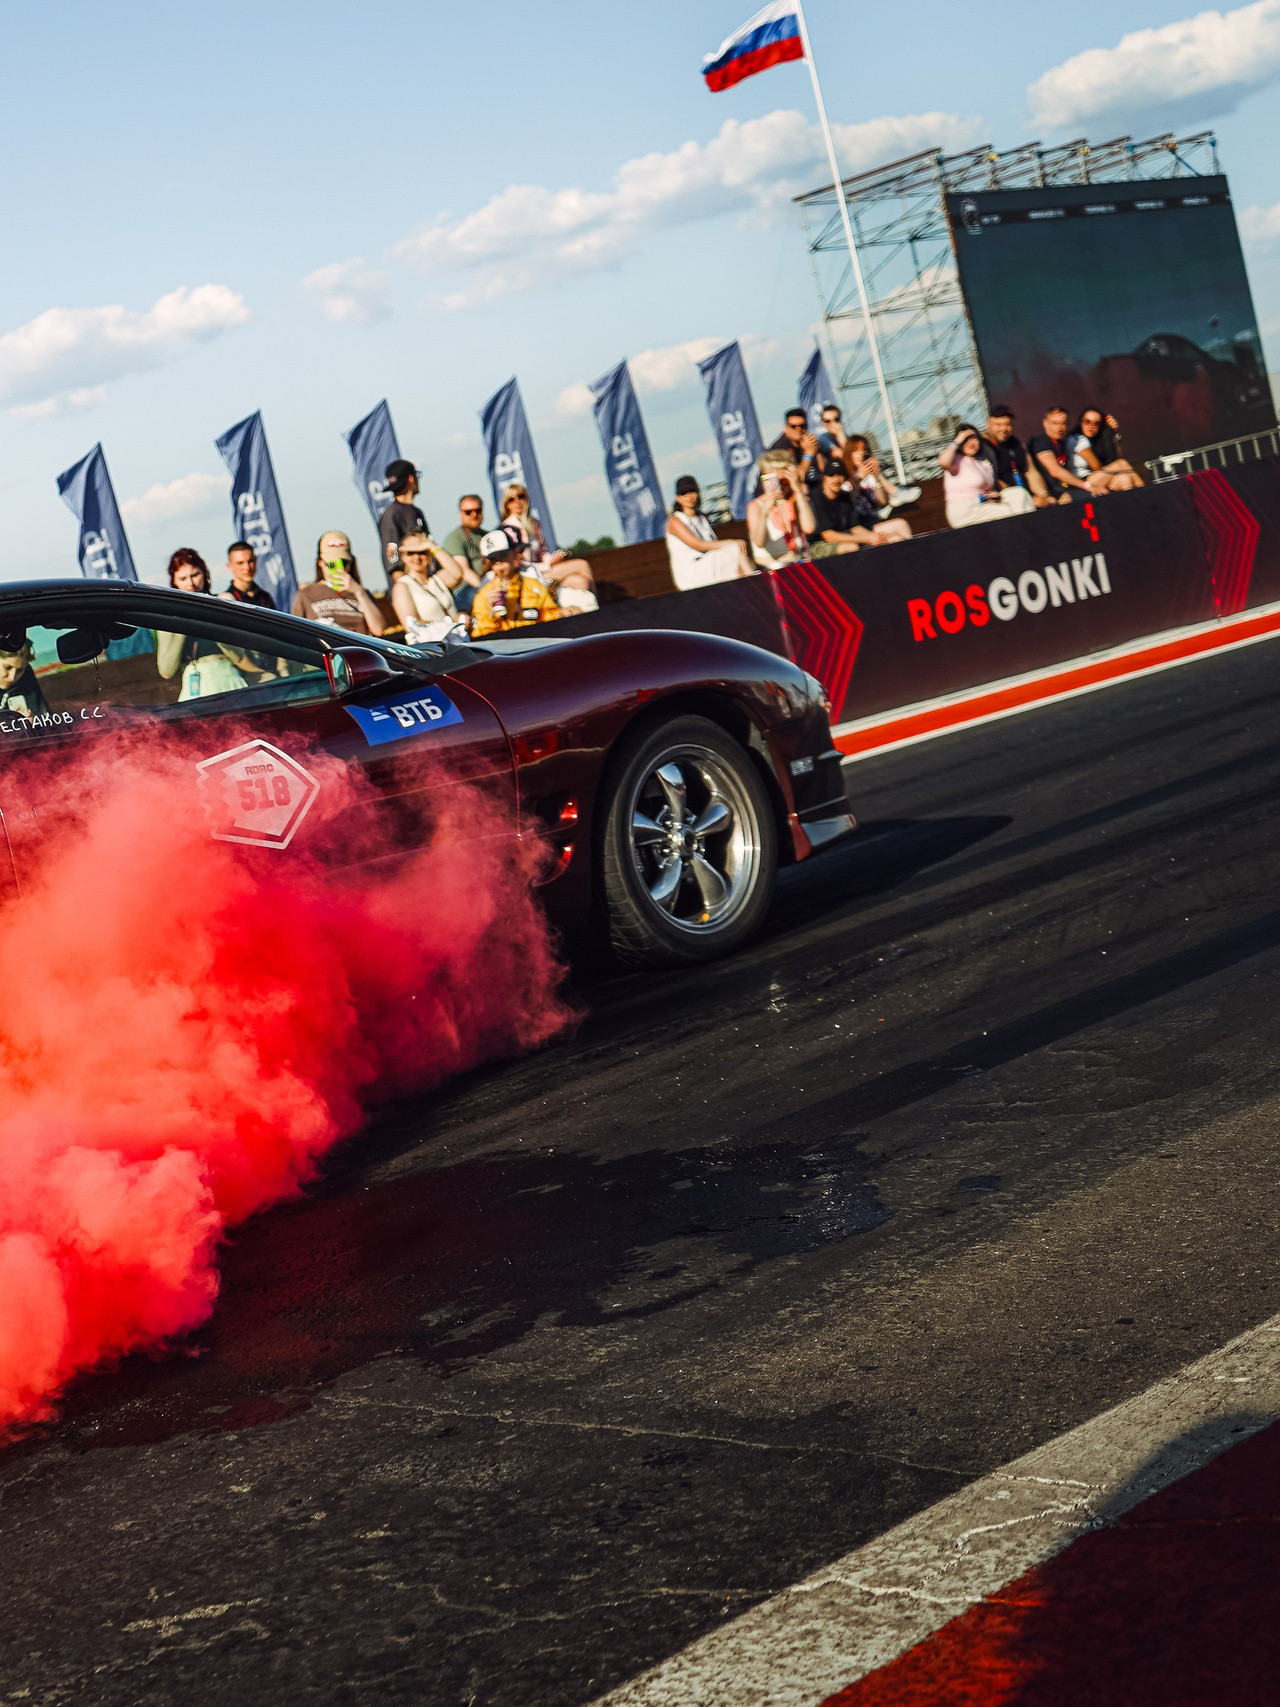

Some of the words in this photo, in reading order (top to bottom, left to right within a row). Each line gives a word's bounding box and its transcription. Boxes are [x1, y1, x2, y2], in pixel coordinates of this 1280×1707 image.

[907, 553, 1111, 642] ROSGONKI
[390, 698, 443, 728] ВТБ
[236, 775, 291, 811] 518
